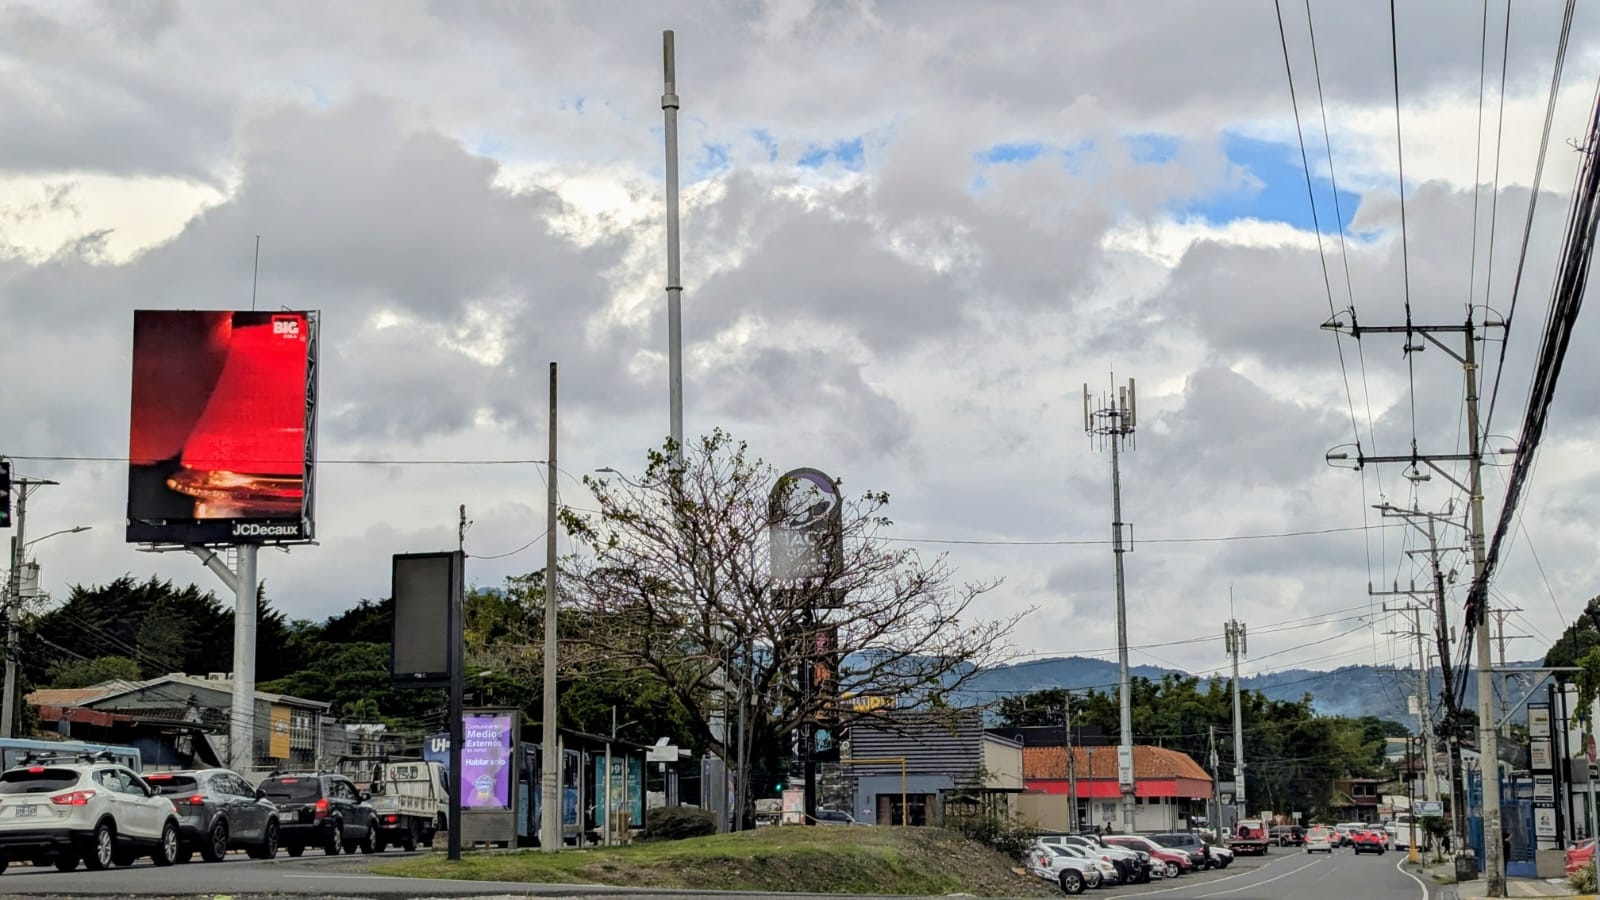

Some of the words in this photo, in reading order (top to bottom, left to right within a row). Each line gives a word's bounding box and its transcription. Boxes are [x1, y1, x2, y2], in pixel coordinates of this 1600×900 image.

[273, 321, 299, 334] BIG
[232, 524, 298, 536] JCDecaux
[467, 729, 503, 738] Medios
[465, 758, 490, 766] Hablar
